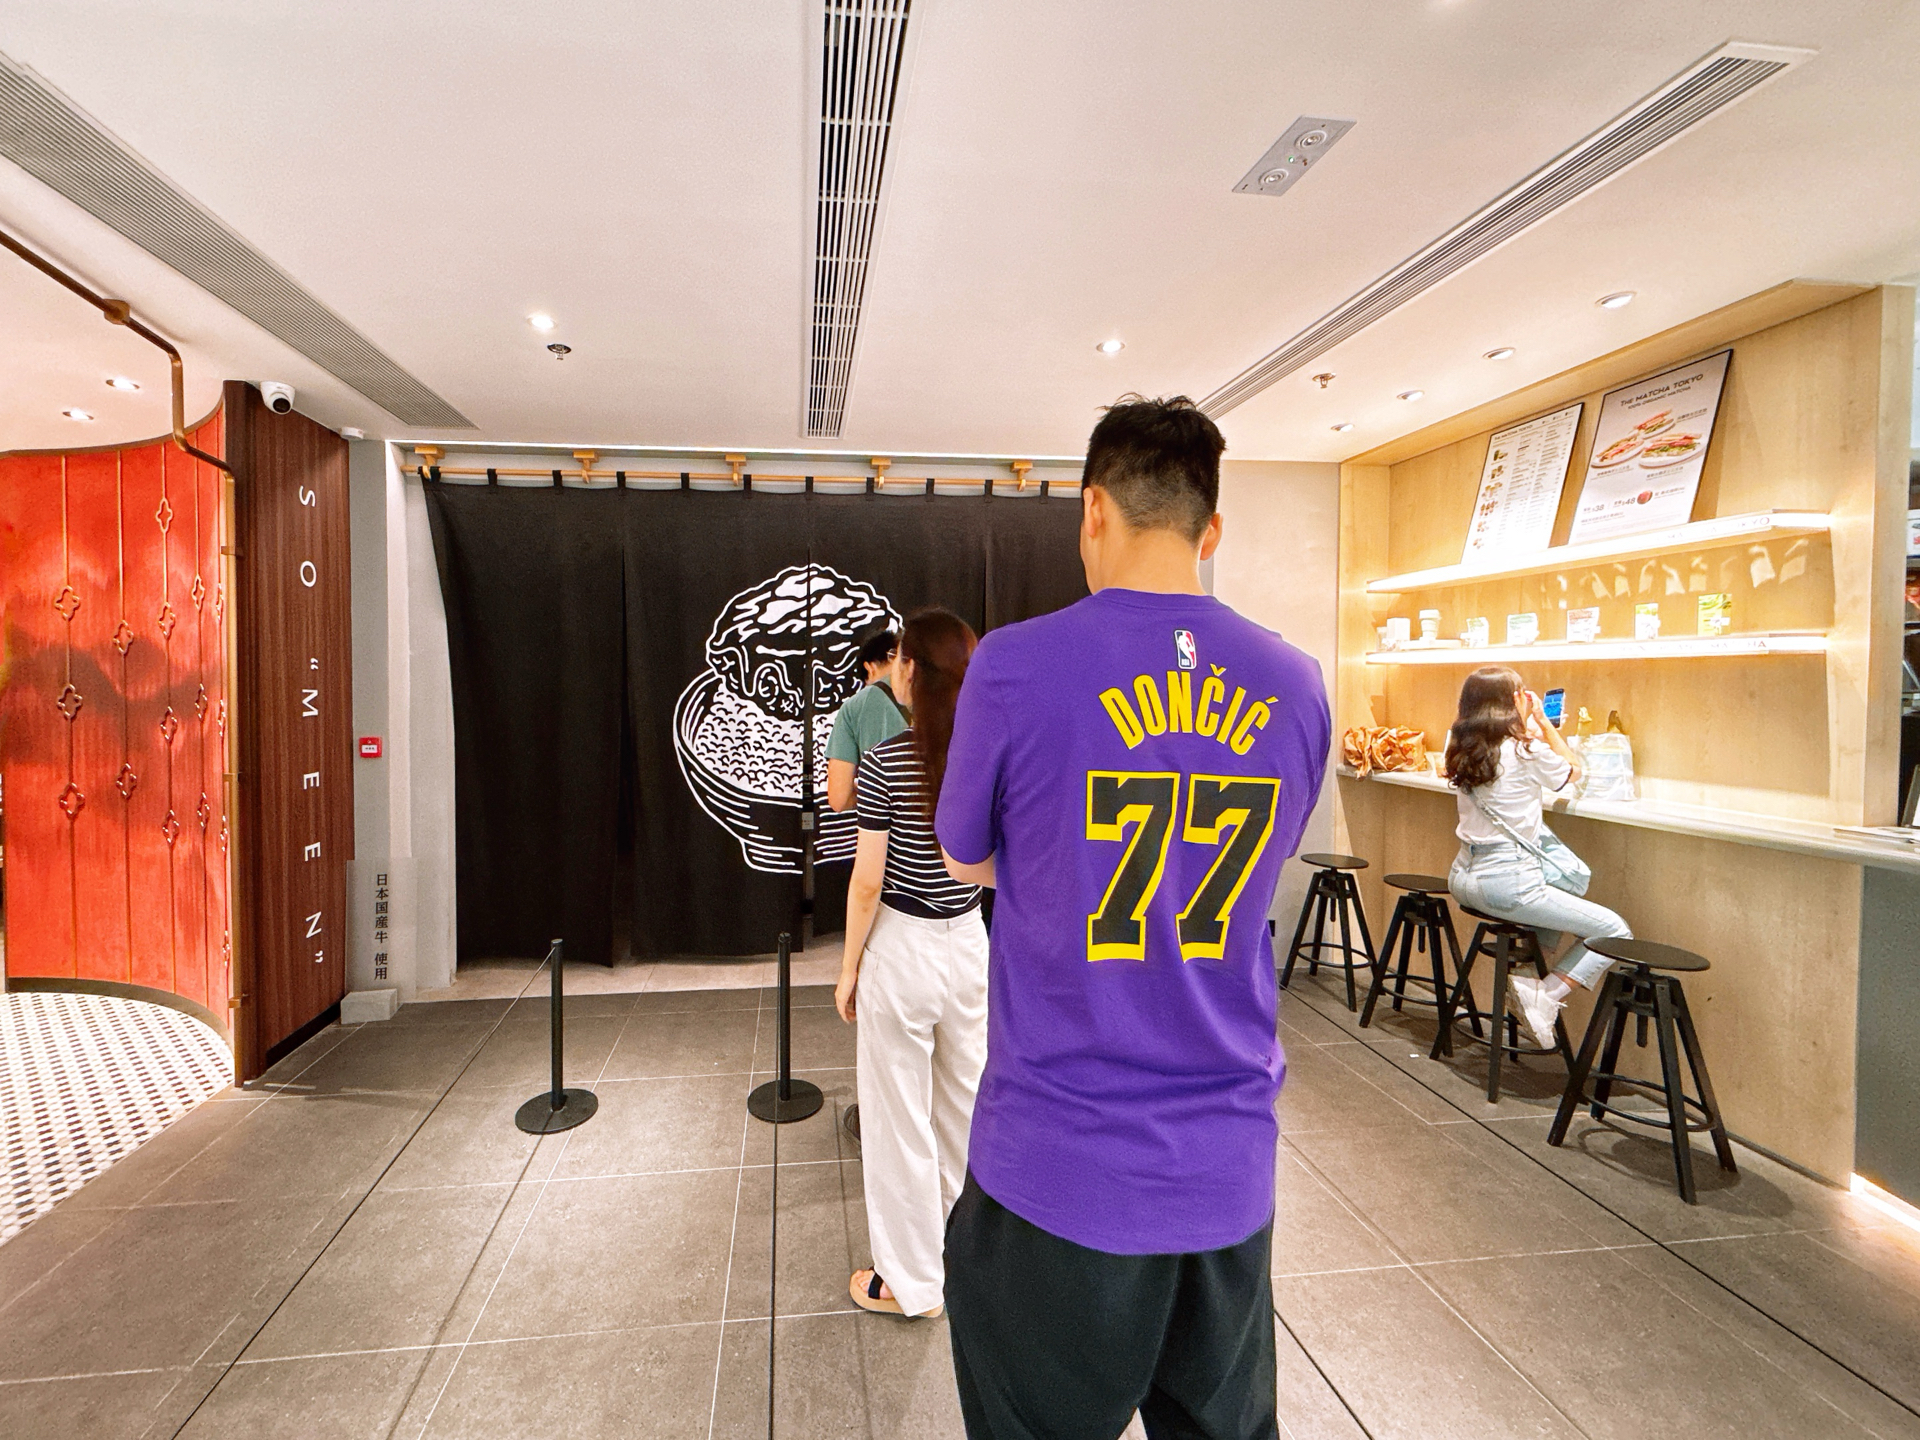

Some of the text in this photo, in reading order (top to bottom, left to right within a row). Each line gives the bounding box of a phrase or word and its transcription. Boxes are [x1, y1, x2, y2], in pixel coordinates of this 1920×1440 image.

[1620, 373, 1704, 406] THE MATCHA TOKYO
[298, 485, 317, 588] SO
[1099, 664, 1279, 756] DONČIĆ
[1086, 770, 1282, 964] 77
[374, 873, 389, 981] 日本国産牛 使用
